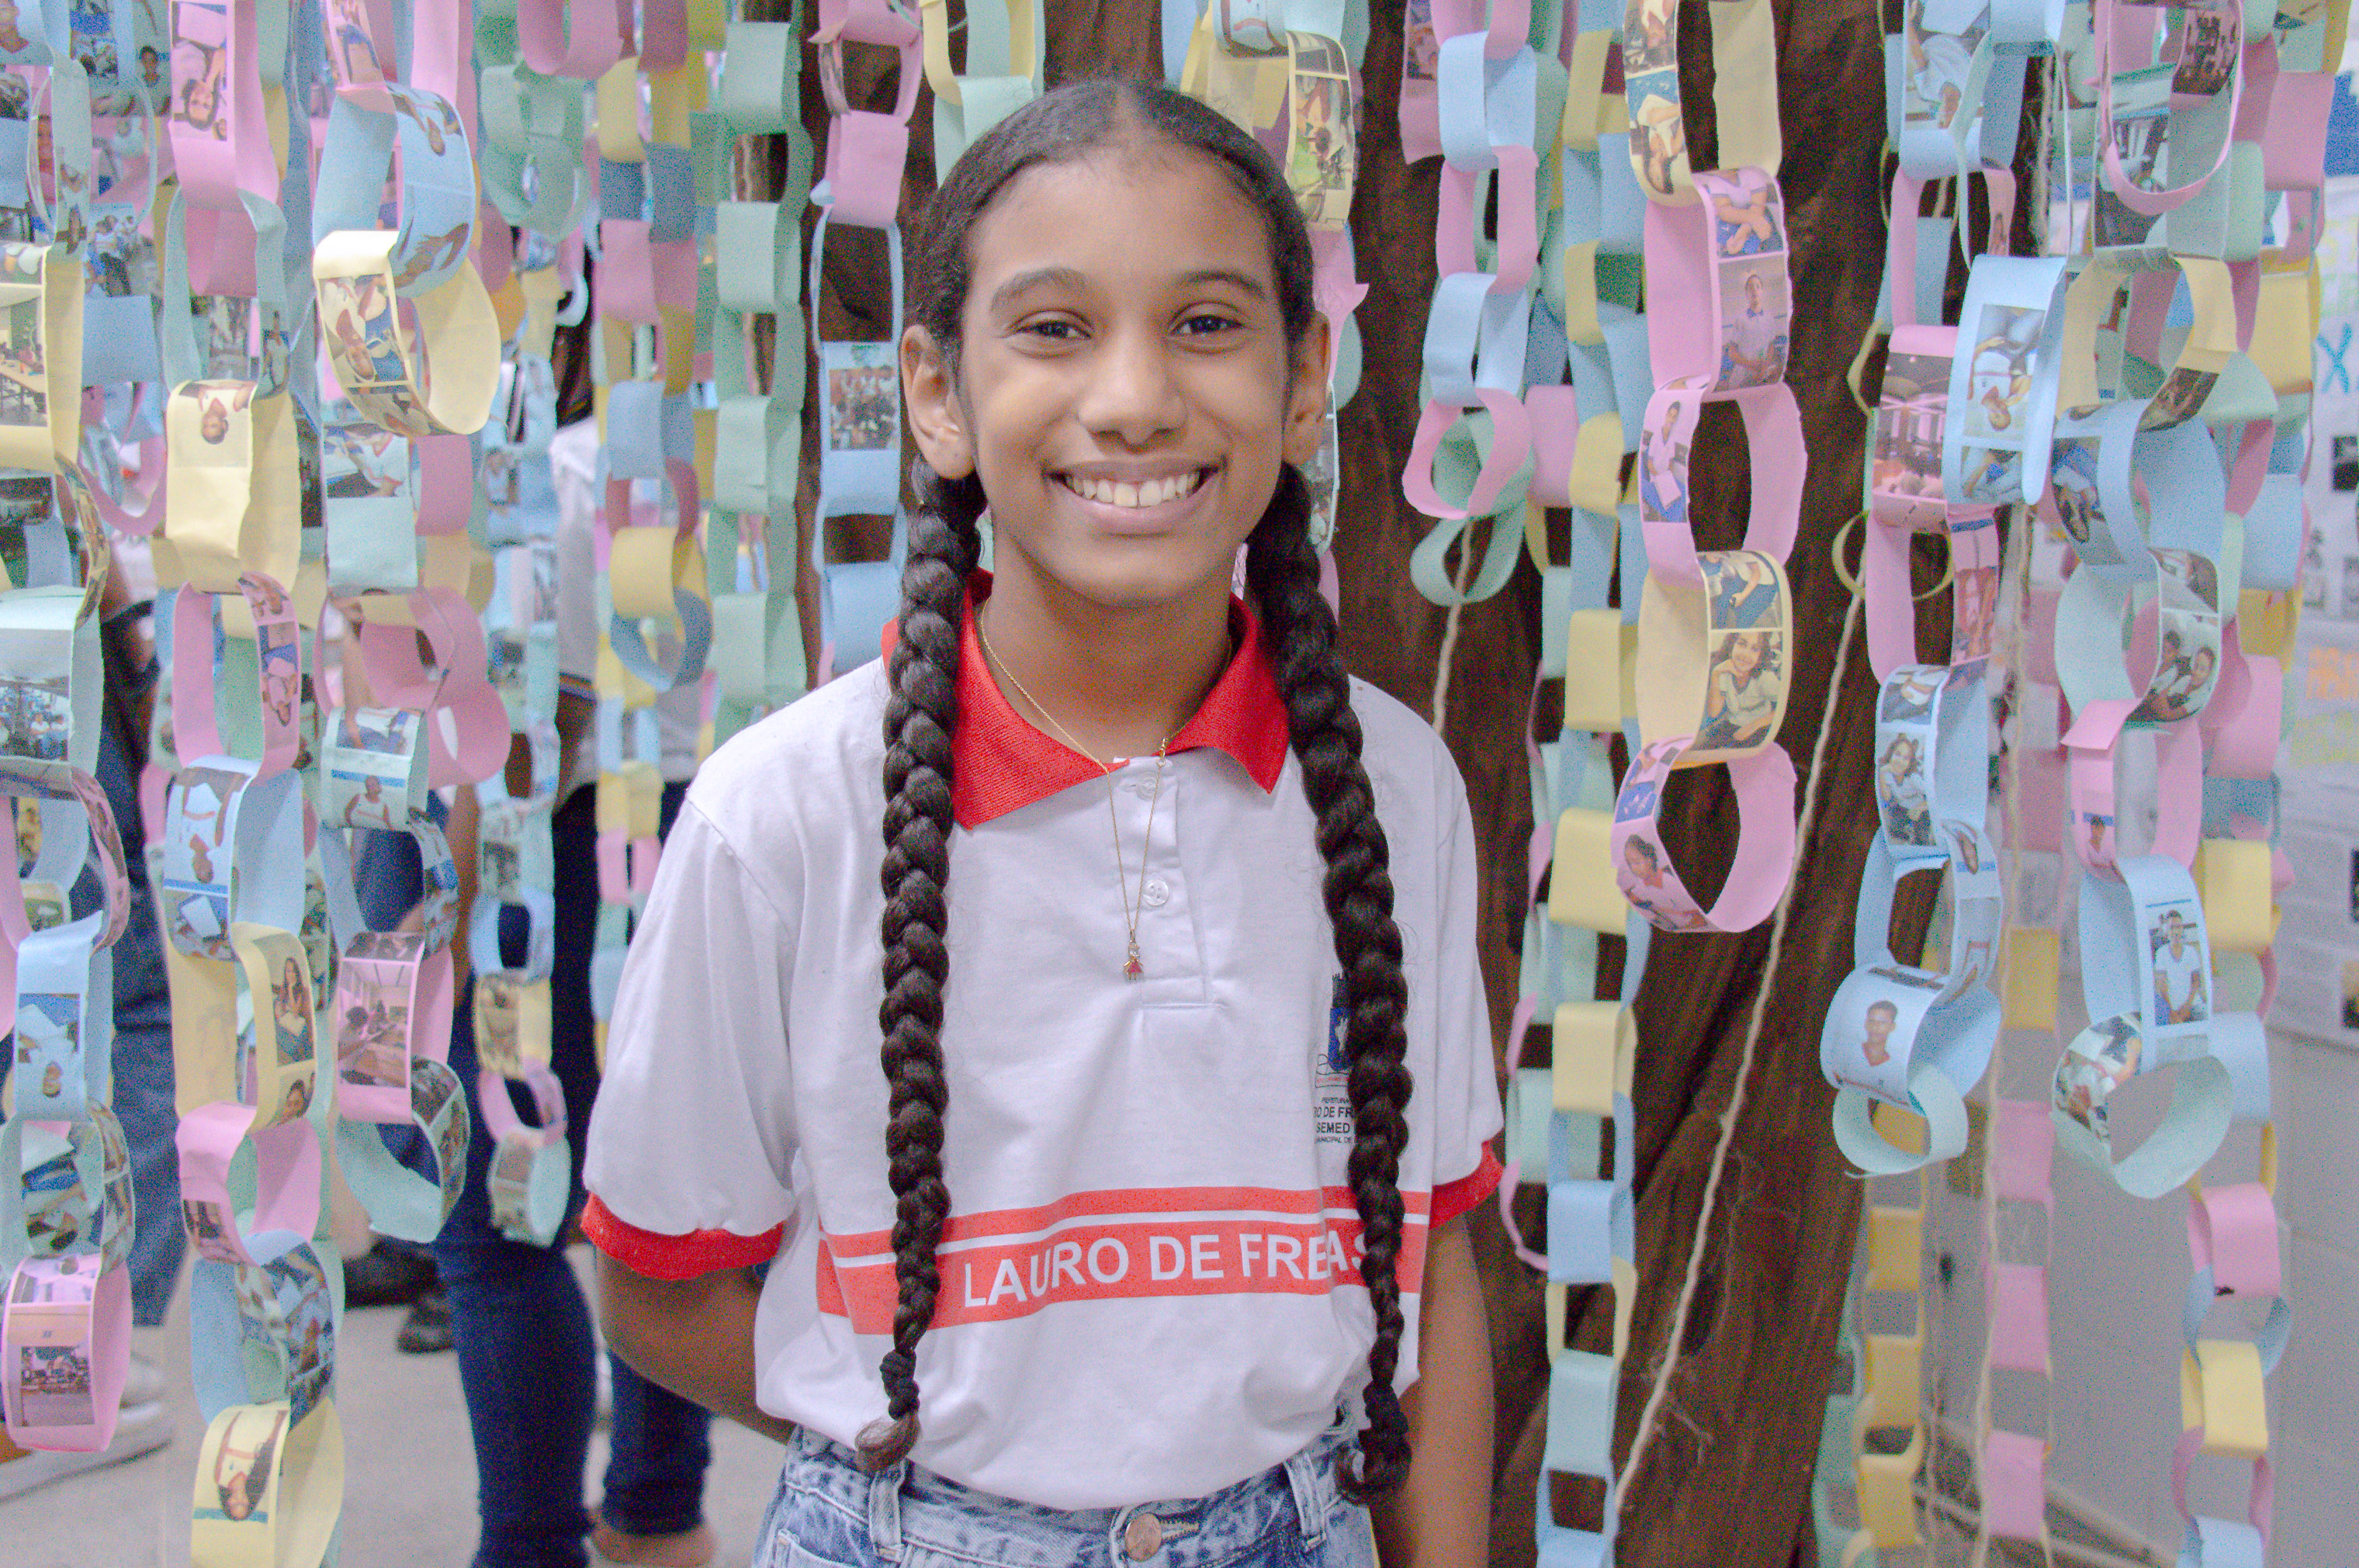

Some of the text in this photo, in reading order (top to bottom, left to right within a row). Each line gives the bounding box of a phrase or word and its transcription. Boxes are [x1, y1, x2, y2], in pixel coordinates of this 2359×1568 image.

[1323, 1106, 1335, 1117] DE
[1316, 1122, 1350, 1134] SEMED
[965, 1237, 1128, 1307] LAURO
[1149, 1234, 1224, 1280] DE
